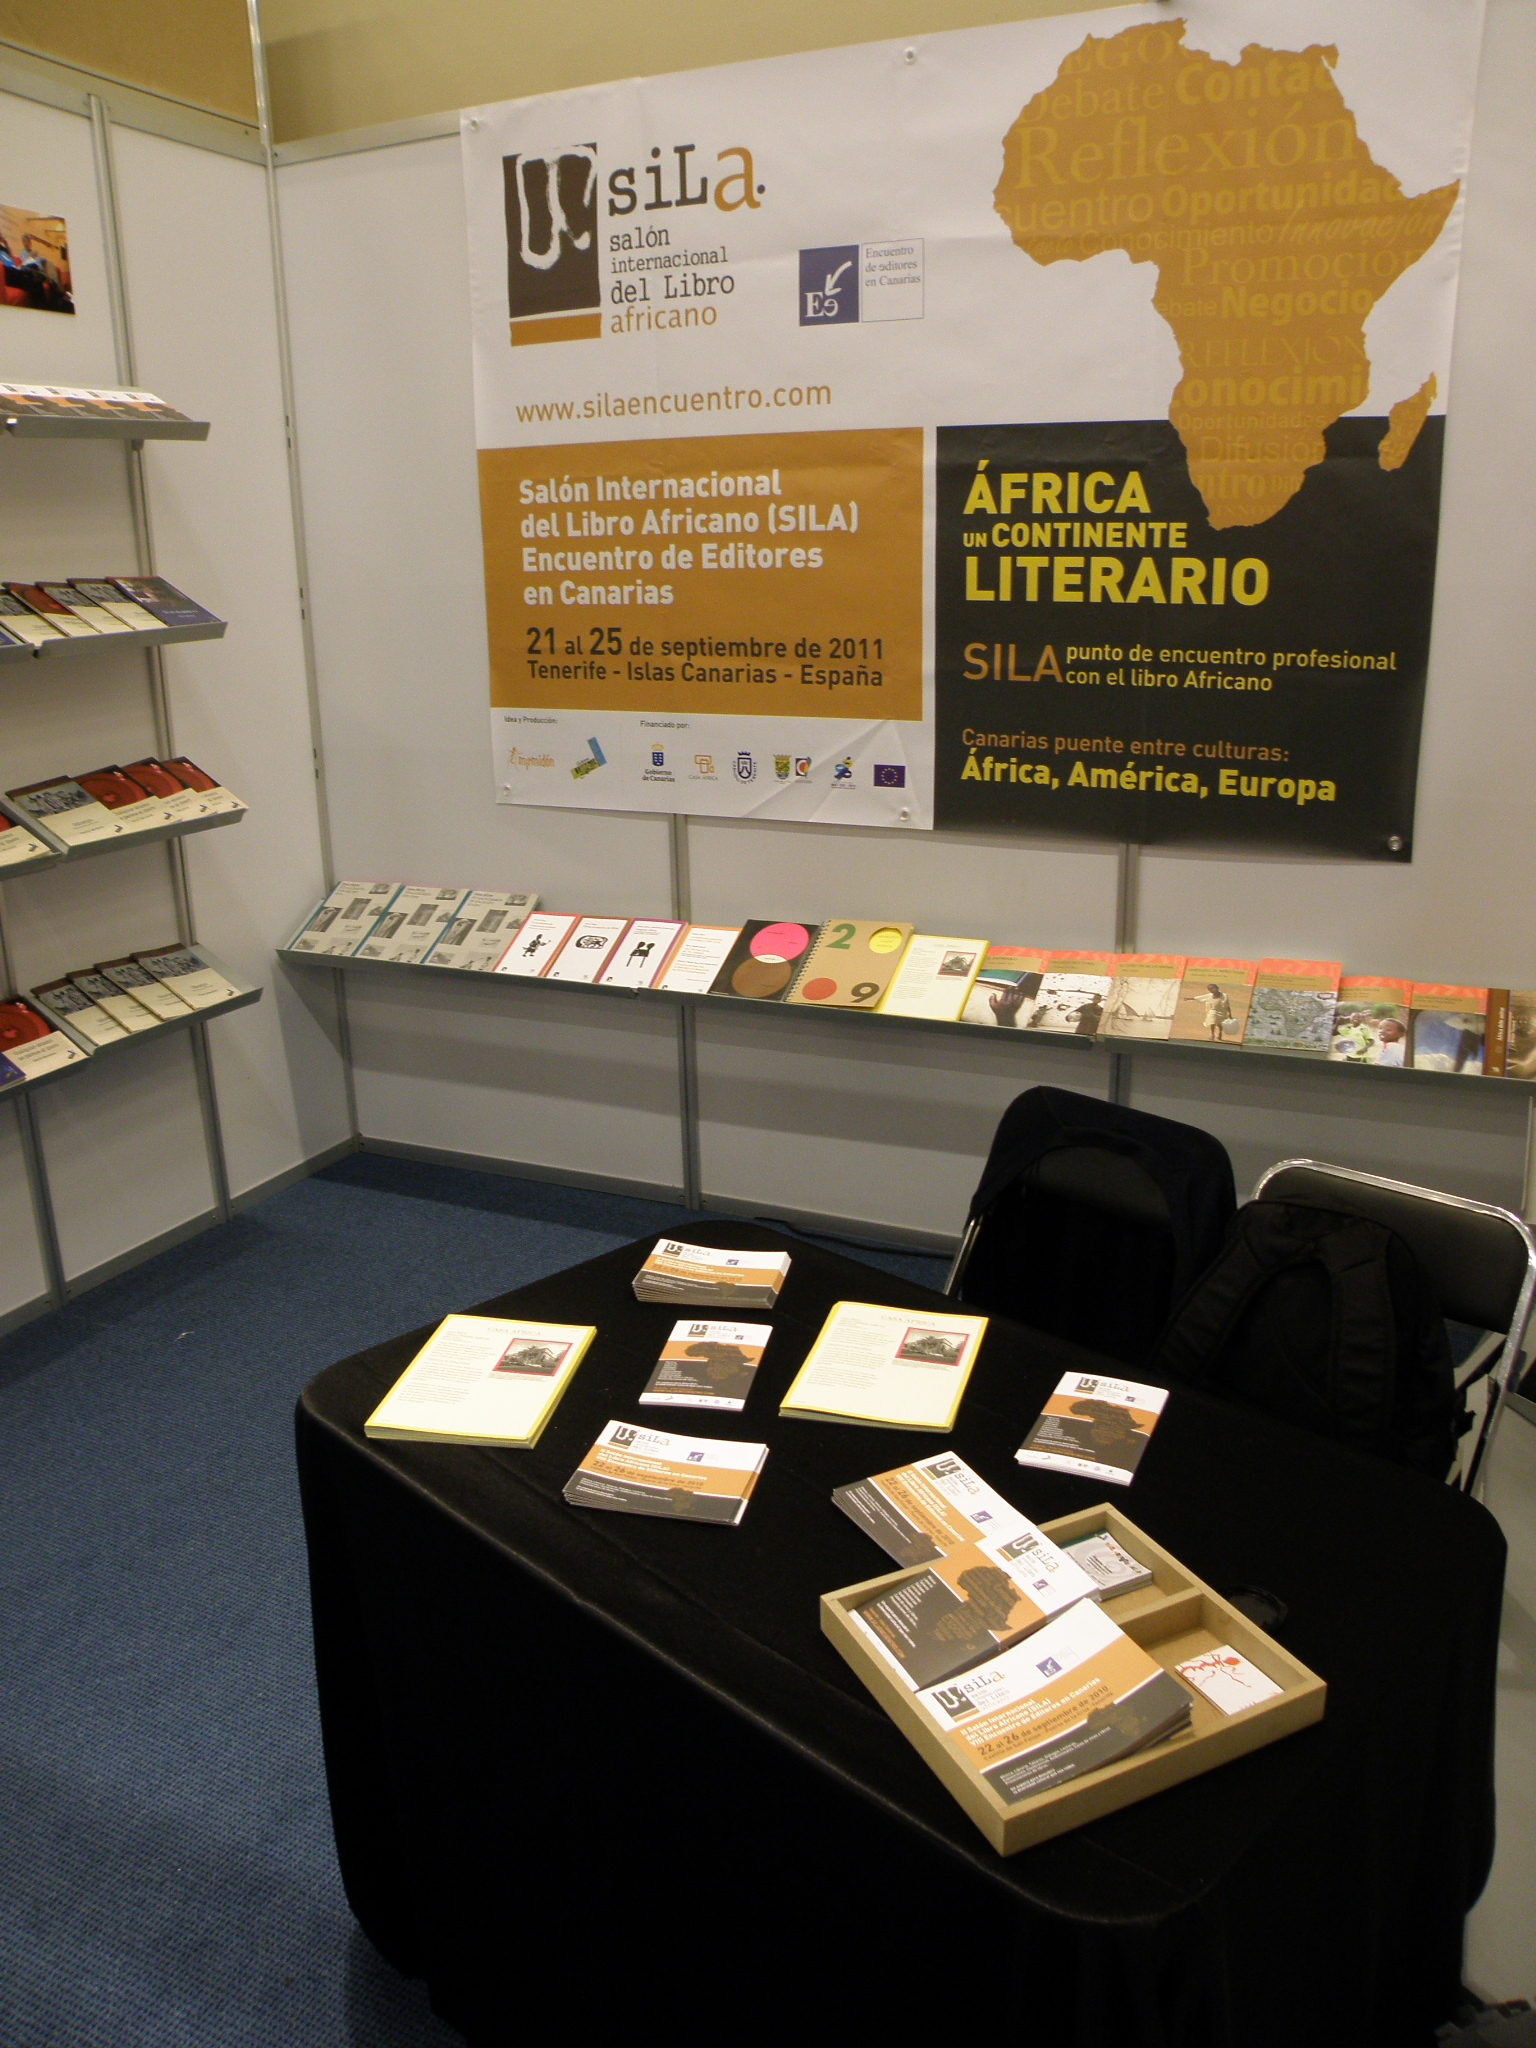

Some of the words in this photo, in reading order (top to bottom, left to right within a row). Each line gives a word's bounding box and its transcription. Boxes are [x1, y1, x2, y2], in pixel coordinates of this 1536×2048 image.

[1059, 27, 1205, 75] EGO
[1014, 101, 1358, 190] Reflexión
[610, 226, 669, 251] salón
[866, 246, 914, 258] Encuentro
[611, 247, 728, 273] internacional
[865, 263, 878, 272] de
[611, 278, 650, 304] del
[665, 273, 734, 299] Libro
[865, 278, 876, 286] en
[880, 274, 920, 286] Canarias
[1222, 281, 1373, 325] Negocio
[611, 306, 717, 333] africano
[1171, 364, 1363, 407] onocimi
[516, 384, 831, 423] www.silaencuentro.com
[519, 475, 589, 504] Salón
[596, 469, 781, 501] Internacional
[963, 460, 1151, 514] ÁFRICA
[521, 512, 559, 538] del
[567, 511, 634, 537] Libro
[642, 508, 759, 535] Africano
[768, 501, 858, 535] (SILA)
[963, 533, 987, 547] UN
[992, 522, 1187, 548] CONTINENTE
[523, 546, 653, 572] Encuentro
[661, 544, 694, 569] de
[702, 544, 823, 568] Editores
[524, 586, 553, 604] en
[560, 579, 674, 604] Canarias
[966, 557, 1269, 605] LITERARIO
[526, 627, 556, 654] 21
[565, 636, 582, 654] al
[589, 627, 622, 655] 25
[630, 637, 653, 656] de
[661, 637, 787, 660] septiembre
[794, 638, 821, 658] de
[829, 638, 883, 659] 2011
[1067, 644, 1122, 664] punto
[1129, 644, 1152, 662] de
[1159, 647, 1266, 665] encuentro
[1272, 648, 1396, 670] profesional
[527, 660, 606, 679] Tenerife
[627, 662, 675, 680] Islas
[681, 662, 777, 683] Canarias
[800, 664, 883, 689] España
[963, 643, 1063, 683] SILA
[1066, 670, 1099, 685] con
[1106, 669, 1125, 686] el
[1131, 669, 1178, 687] libro
[1184, 670, 1272, 691] Africano
[524, 716, 558, 724] Producción:
[962, 729, 1048, 750] Canarias
[1054, 735, 1124, 756] puente
[1130, 740, 1185, 756] entre
[1193, 740, 1289, 762] culturas:
[961, 747, 1059, 790] África,
[1068, 762, 1208, 799] América,
[1219, 769, 1336, 805] Europa
[826, 923, 857, 949] 2
[966, 1718, 989, 1733] Salón
[987, 1697, 1035, 1725] Internacional
[977, 1742, 994, 1755] 22
[1003, 1732, 1019, 1744] 26
[1019, 1726, 1031, 1737] de
[1031, 1704, 1078, 1733] septiembre
[1077, 1697, 1089, 1707] de
[1087, 1685, 1109, 1700] 2010
[977, 1722, 999, 1736] Libro
[998, 1708, 1028, 1727] Africano
[983, 1719, 1021, 1742] Encuentro
[1020, 1715, 1031, 1724] de
[1029, 1699, 1061, 1719] Editores
[1059, 1695, 1070, 1703] en
[1067, 1676, 1101, 1698] Canarias
